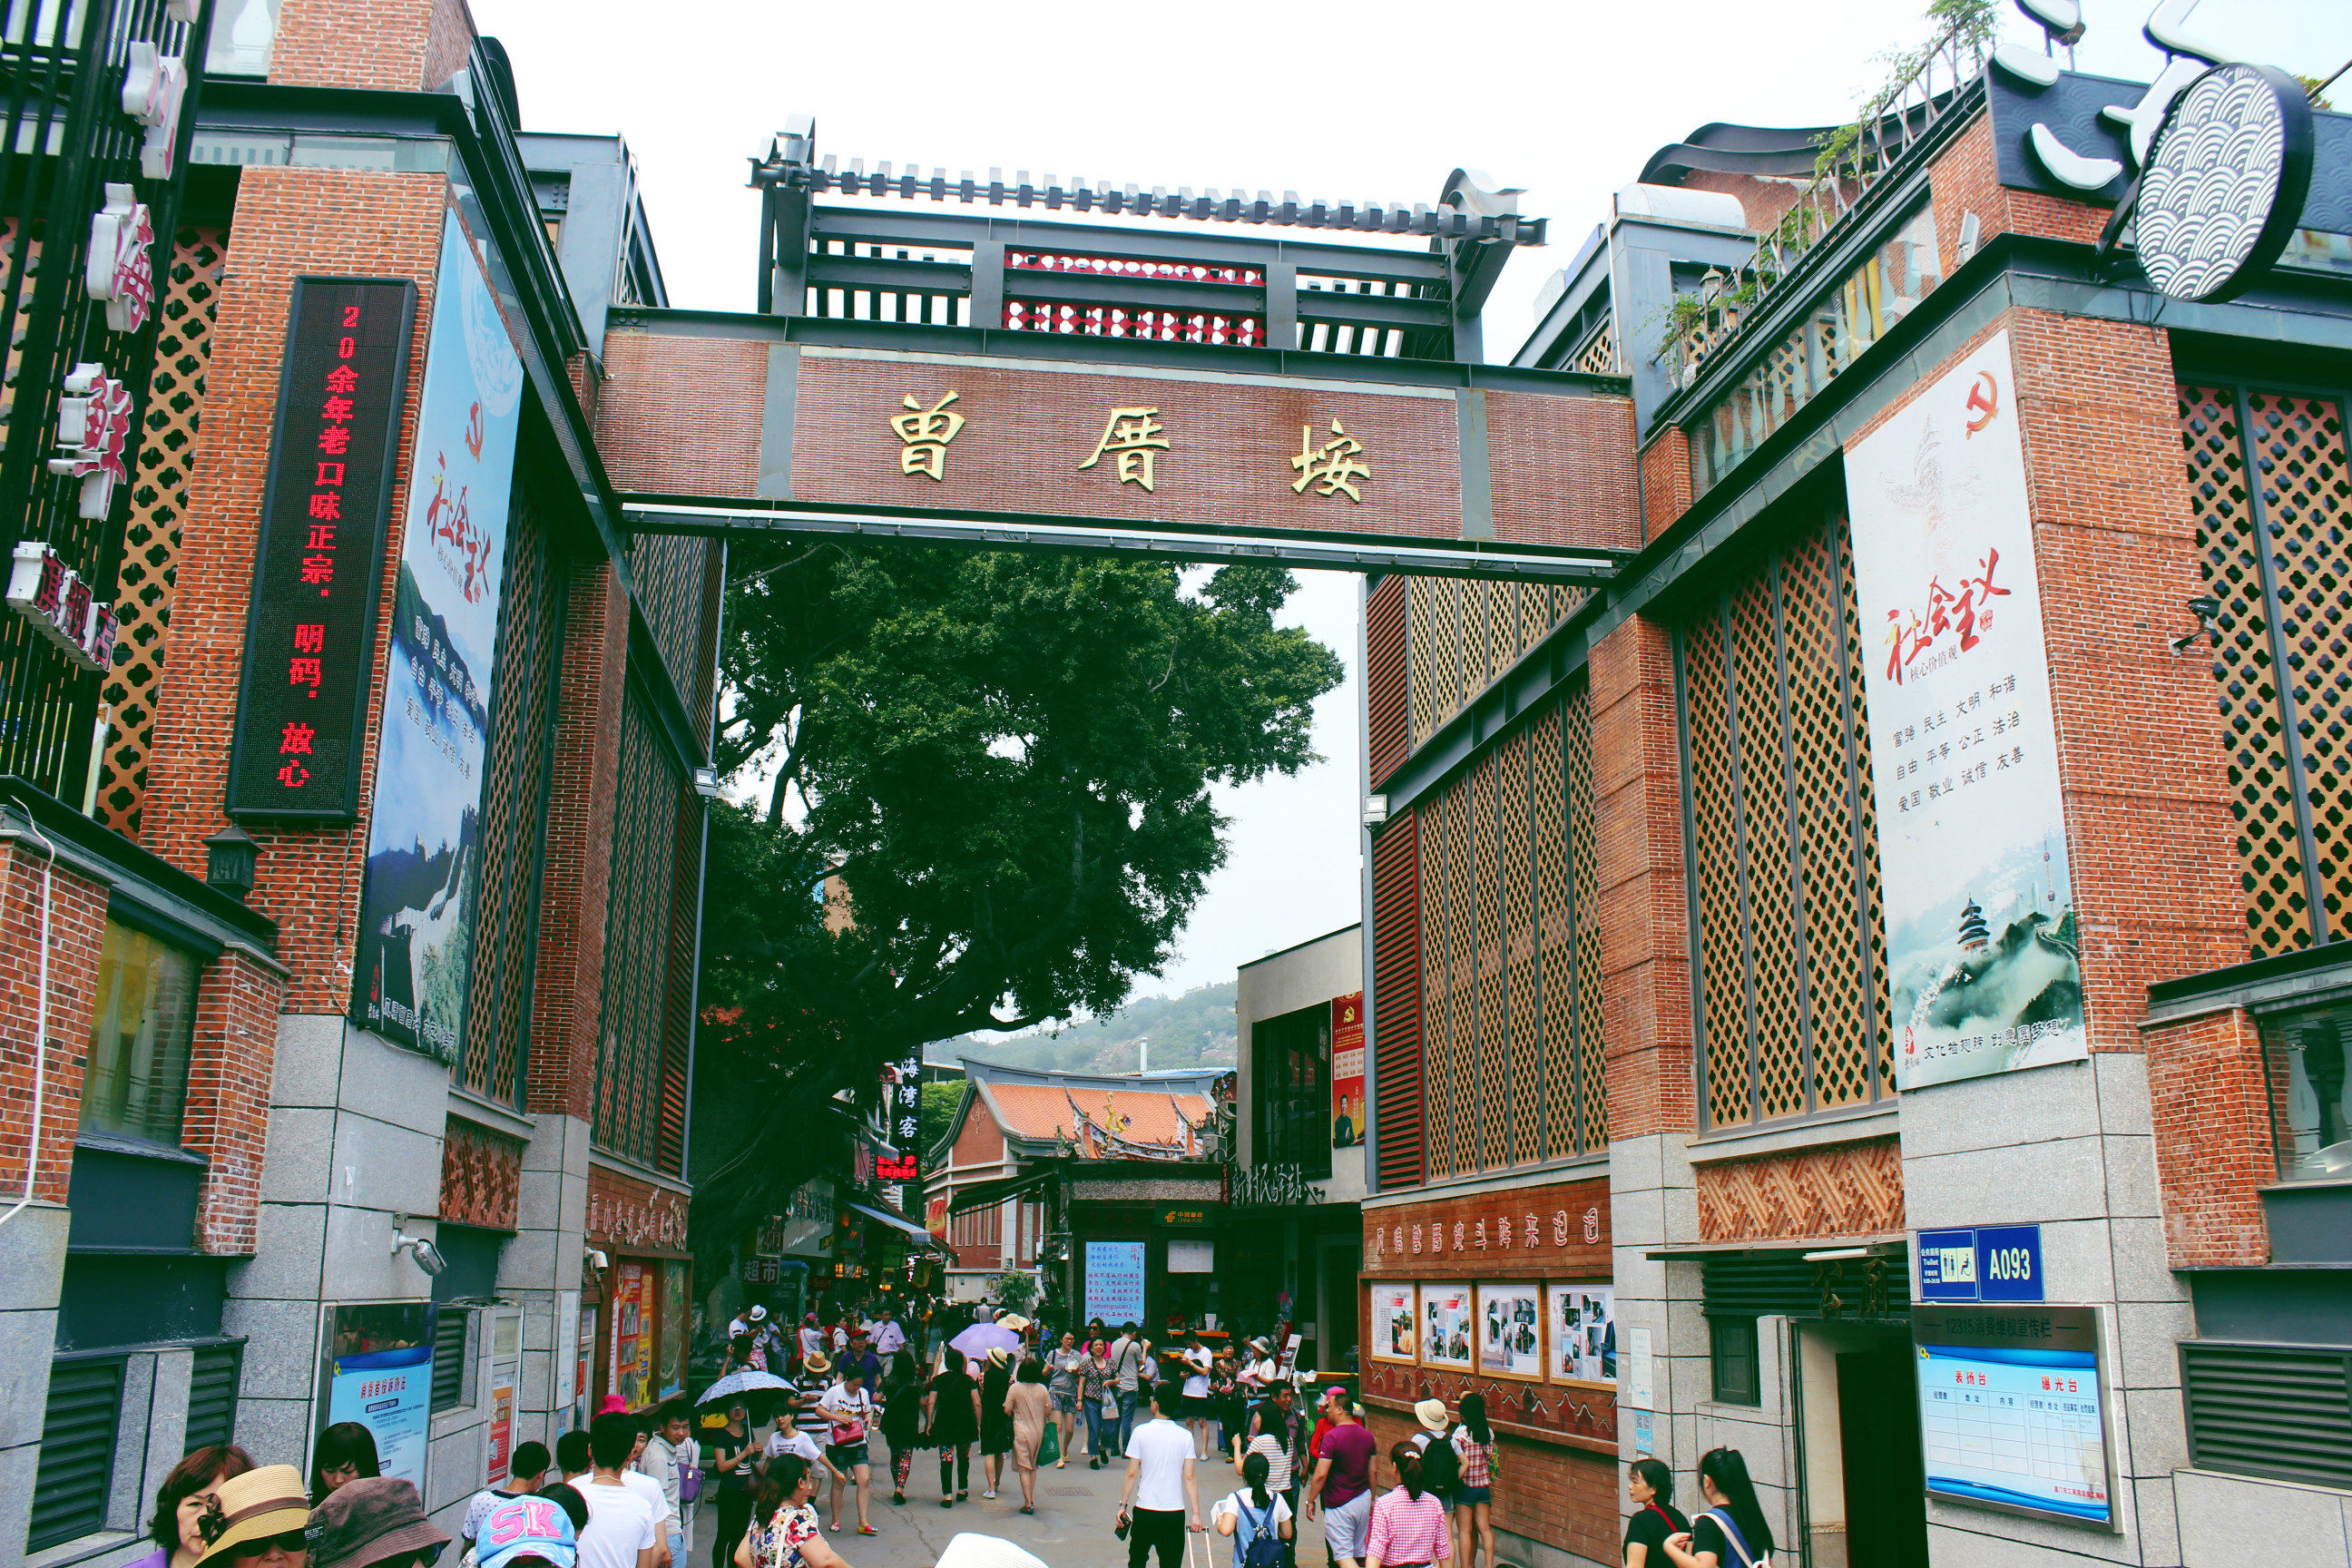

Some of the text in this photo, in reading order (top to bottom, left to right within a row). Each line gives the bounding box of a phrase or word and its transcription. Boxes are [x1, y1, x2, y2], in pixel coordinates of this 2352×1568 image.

[889, 389, 1371, 503] 曾厝垵
[426, 450, 492, 604] 社会主义
[1884, 546, 2012, 686] 社会主义
[411, 655, 426, 688] 自由
[1909, 644, 1958, 682] 核心价值观
[1893, 673, 2016, 748] 富强 民主 文明 和谐
[1896, 710, 2020, 781] 自由 平等 公正 法治
[1898, 745, 2024, 813] 爱国 敬业 诚信 友善
[1923, 1018, 2060, 1060] 文化插翅膀 创意圆梦想
[744, 1259, 778, 1283] 超市
[1920, 1248, 1940, 1257] 公共厕所
[1989, 1248, 2031, 1280] A093
[1945, 1317, 2053, 1339] 12315消费维权宣传栏
[359, 1375, 407, 1399] 消费者投诉办法
[1954, 1369, 1987, 1387] 表扬台
[2041, 1376, 2078, 1393] 曝光台
[490, 1500, 562, 1545] SK
